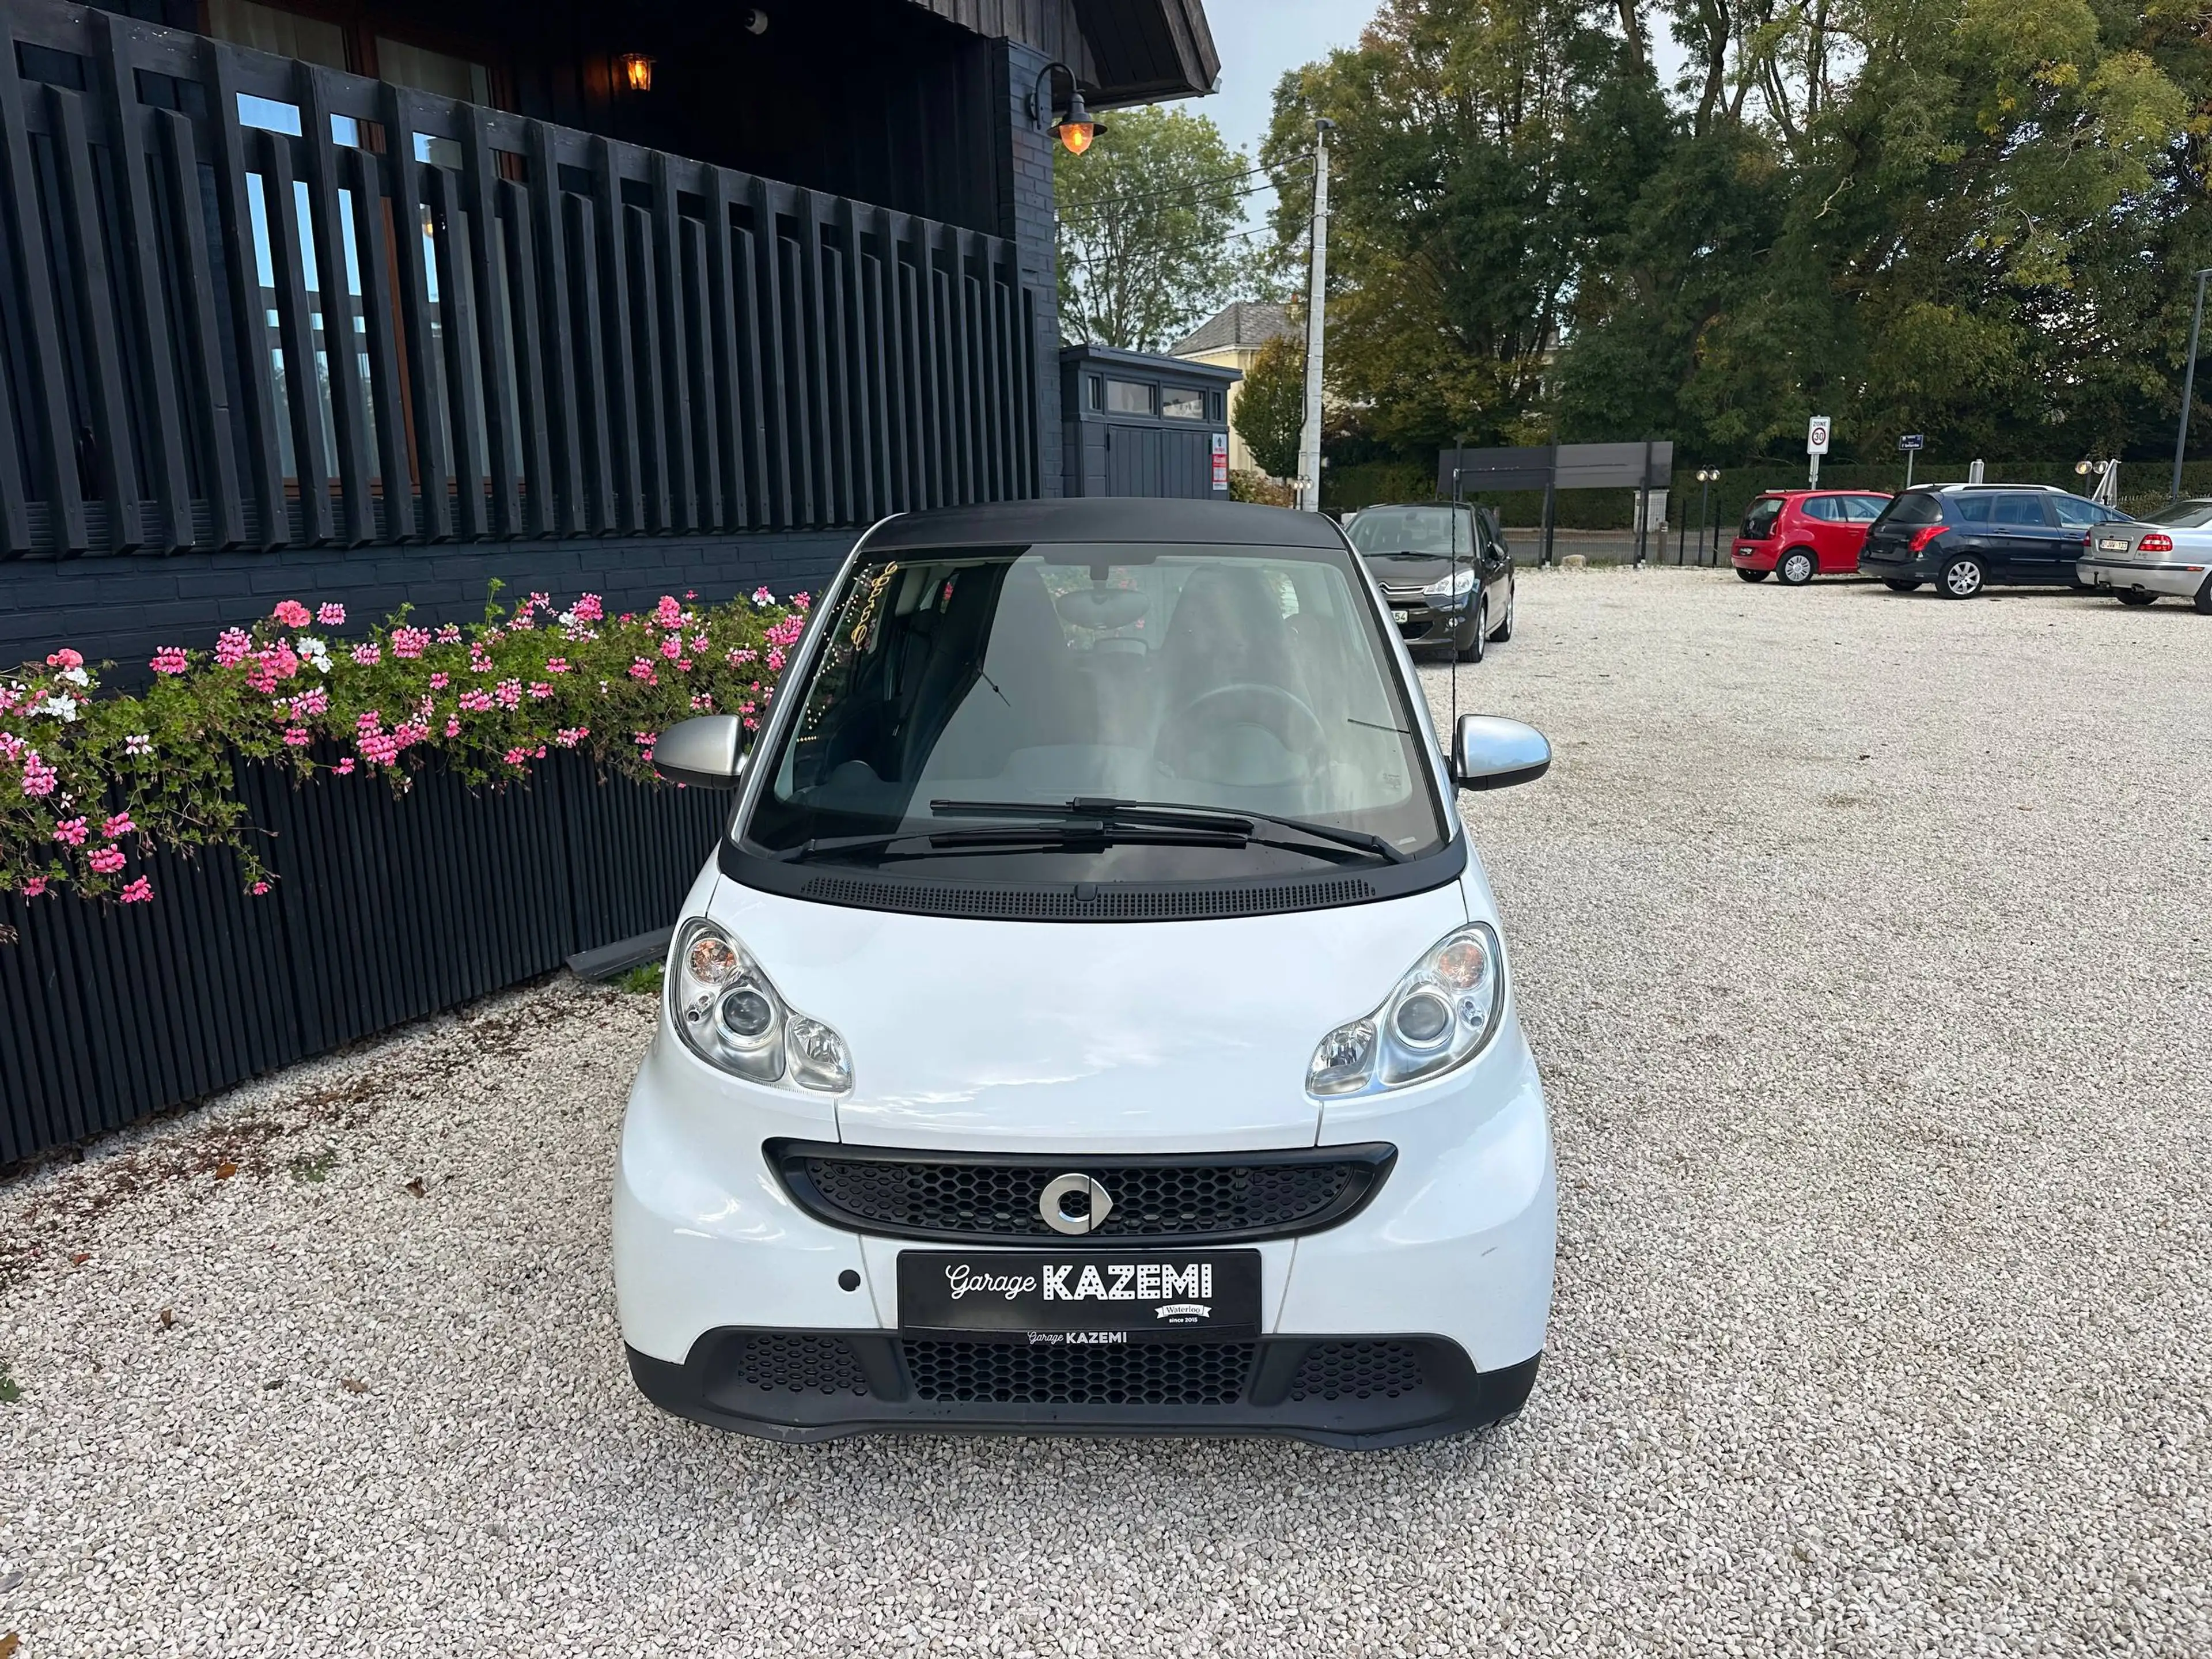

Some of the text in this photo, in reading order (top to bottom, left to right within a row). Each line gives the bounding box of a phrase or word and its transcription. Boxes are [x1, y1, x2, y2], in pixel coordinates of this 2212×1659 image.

[1815, 432, 1824, 441] 30
[945, 1264, 1213, 1300] Garage KAZEMI
[1166, 1305, 1200, 1313] Waterloo
[1027, 1331, 1127, 1345] Garage KAZEMI
